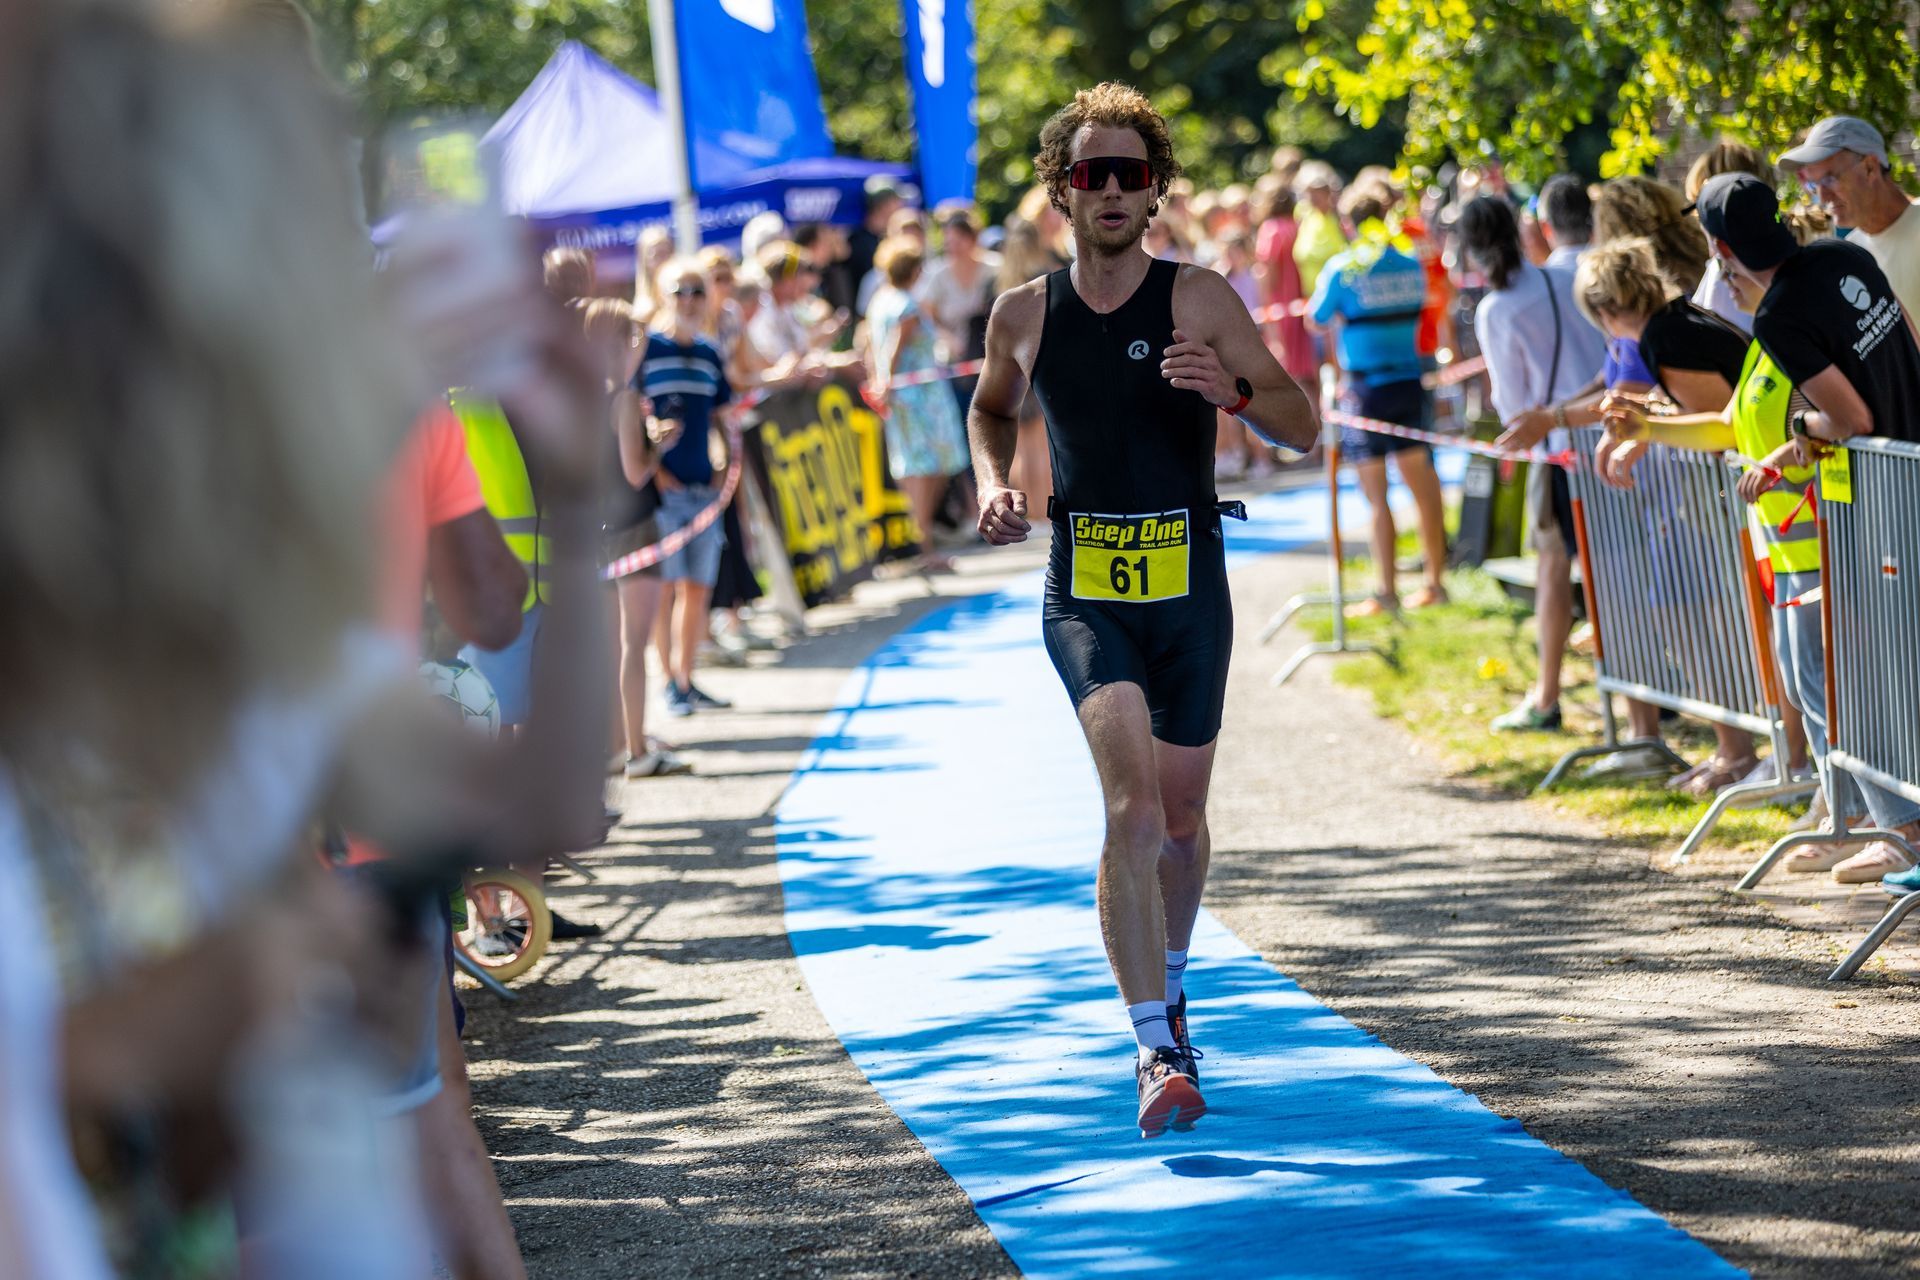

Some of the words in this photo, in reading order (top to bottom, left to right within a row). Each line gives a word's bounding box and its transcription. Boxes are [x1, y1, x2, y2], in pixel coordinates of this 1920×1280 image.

[1856, 314, 1873, 331] Club
[1869, 296, 1888, 319] Sports
[1076, 517, 1135, 548] Step
[1140, 519, 1185, 541] One
[1076, 539, 1105, 548] TRIATHLON
[1110, 556, 1149, 596] 61
